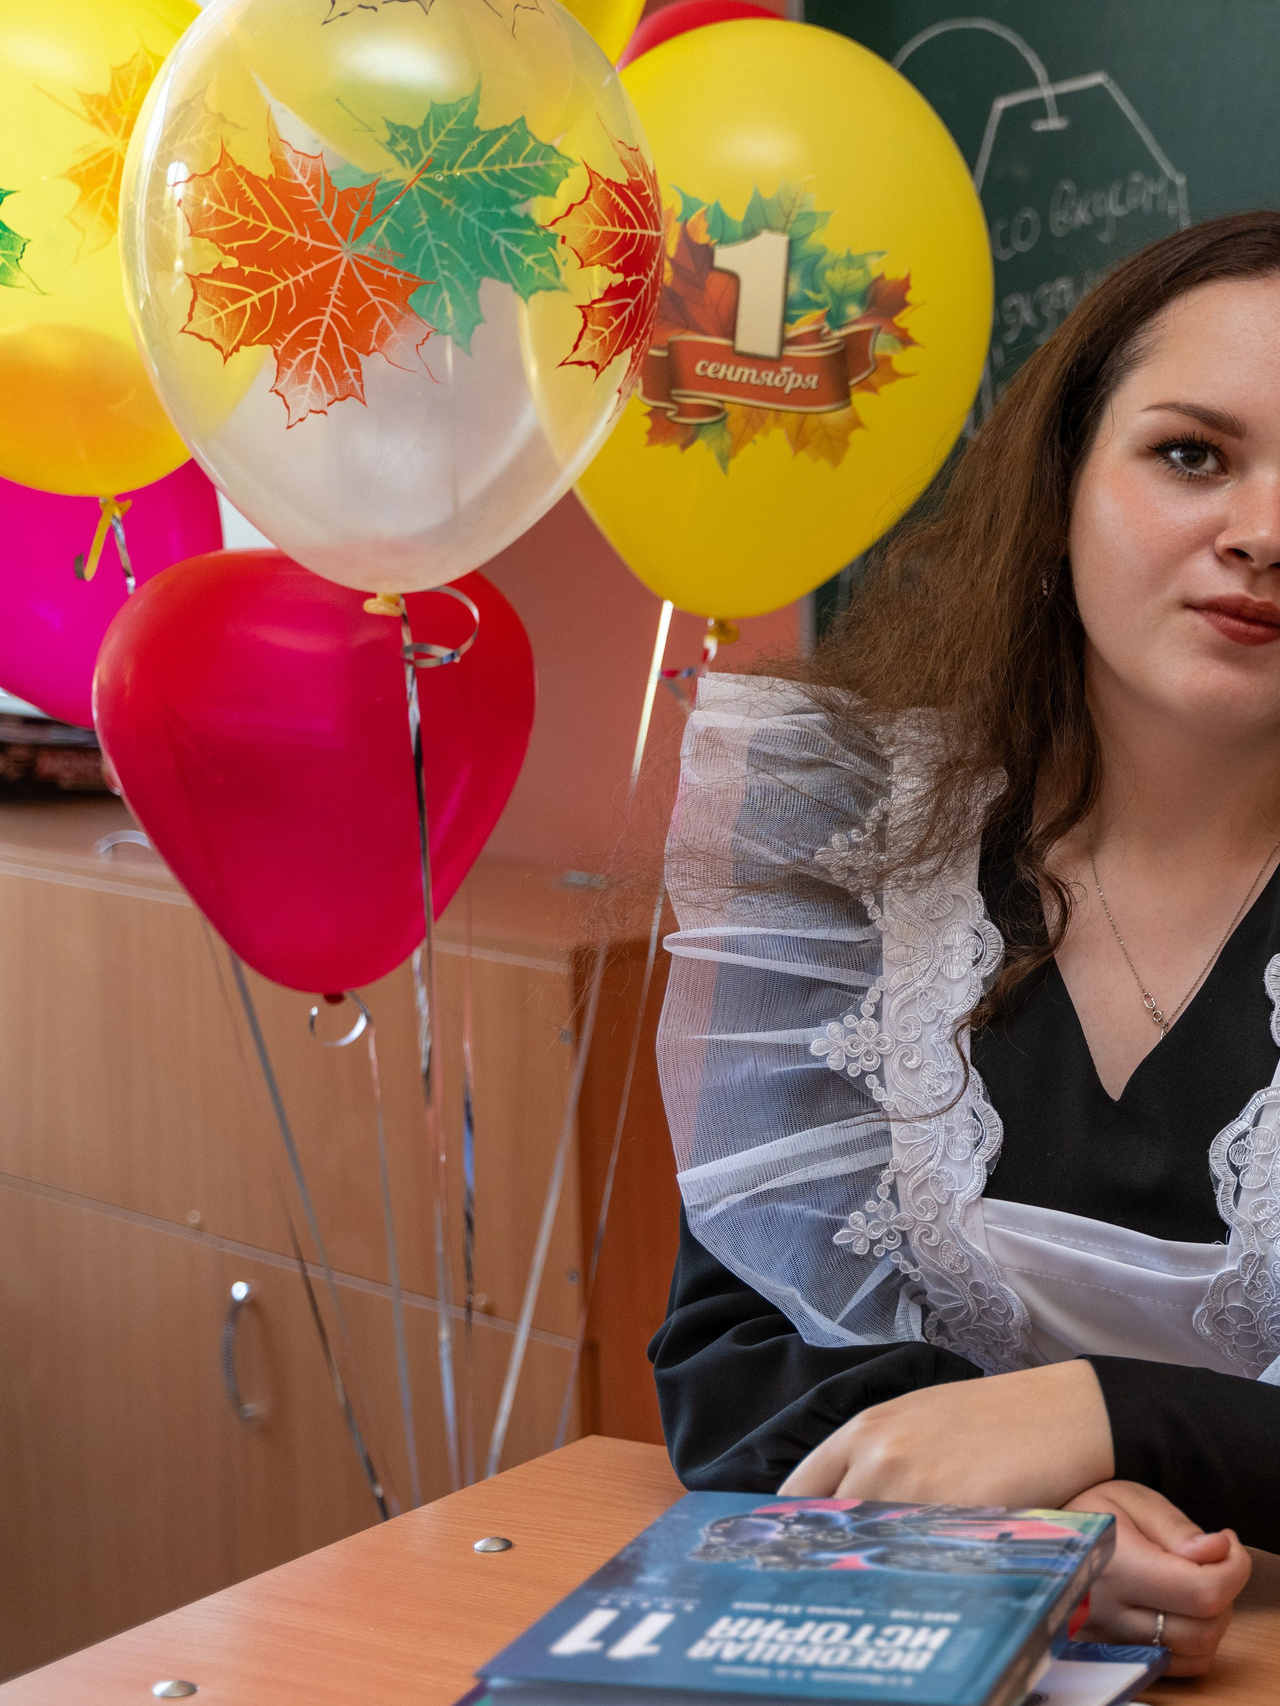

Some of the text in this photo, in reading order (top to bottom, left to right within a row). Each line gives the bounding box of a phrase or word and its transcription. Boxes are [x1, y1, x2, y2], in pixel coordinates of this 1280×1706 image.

[713, 229, 790, 360] 1
[695, 359, 819, 394] сентября
[547, 1606, 677, 1661] 11
[704, 1615, 953, 1651] ИСТОРИЯ
